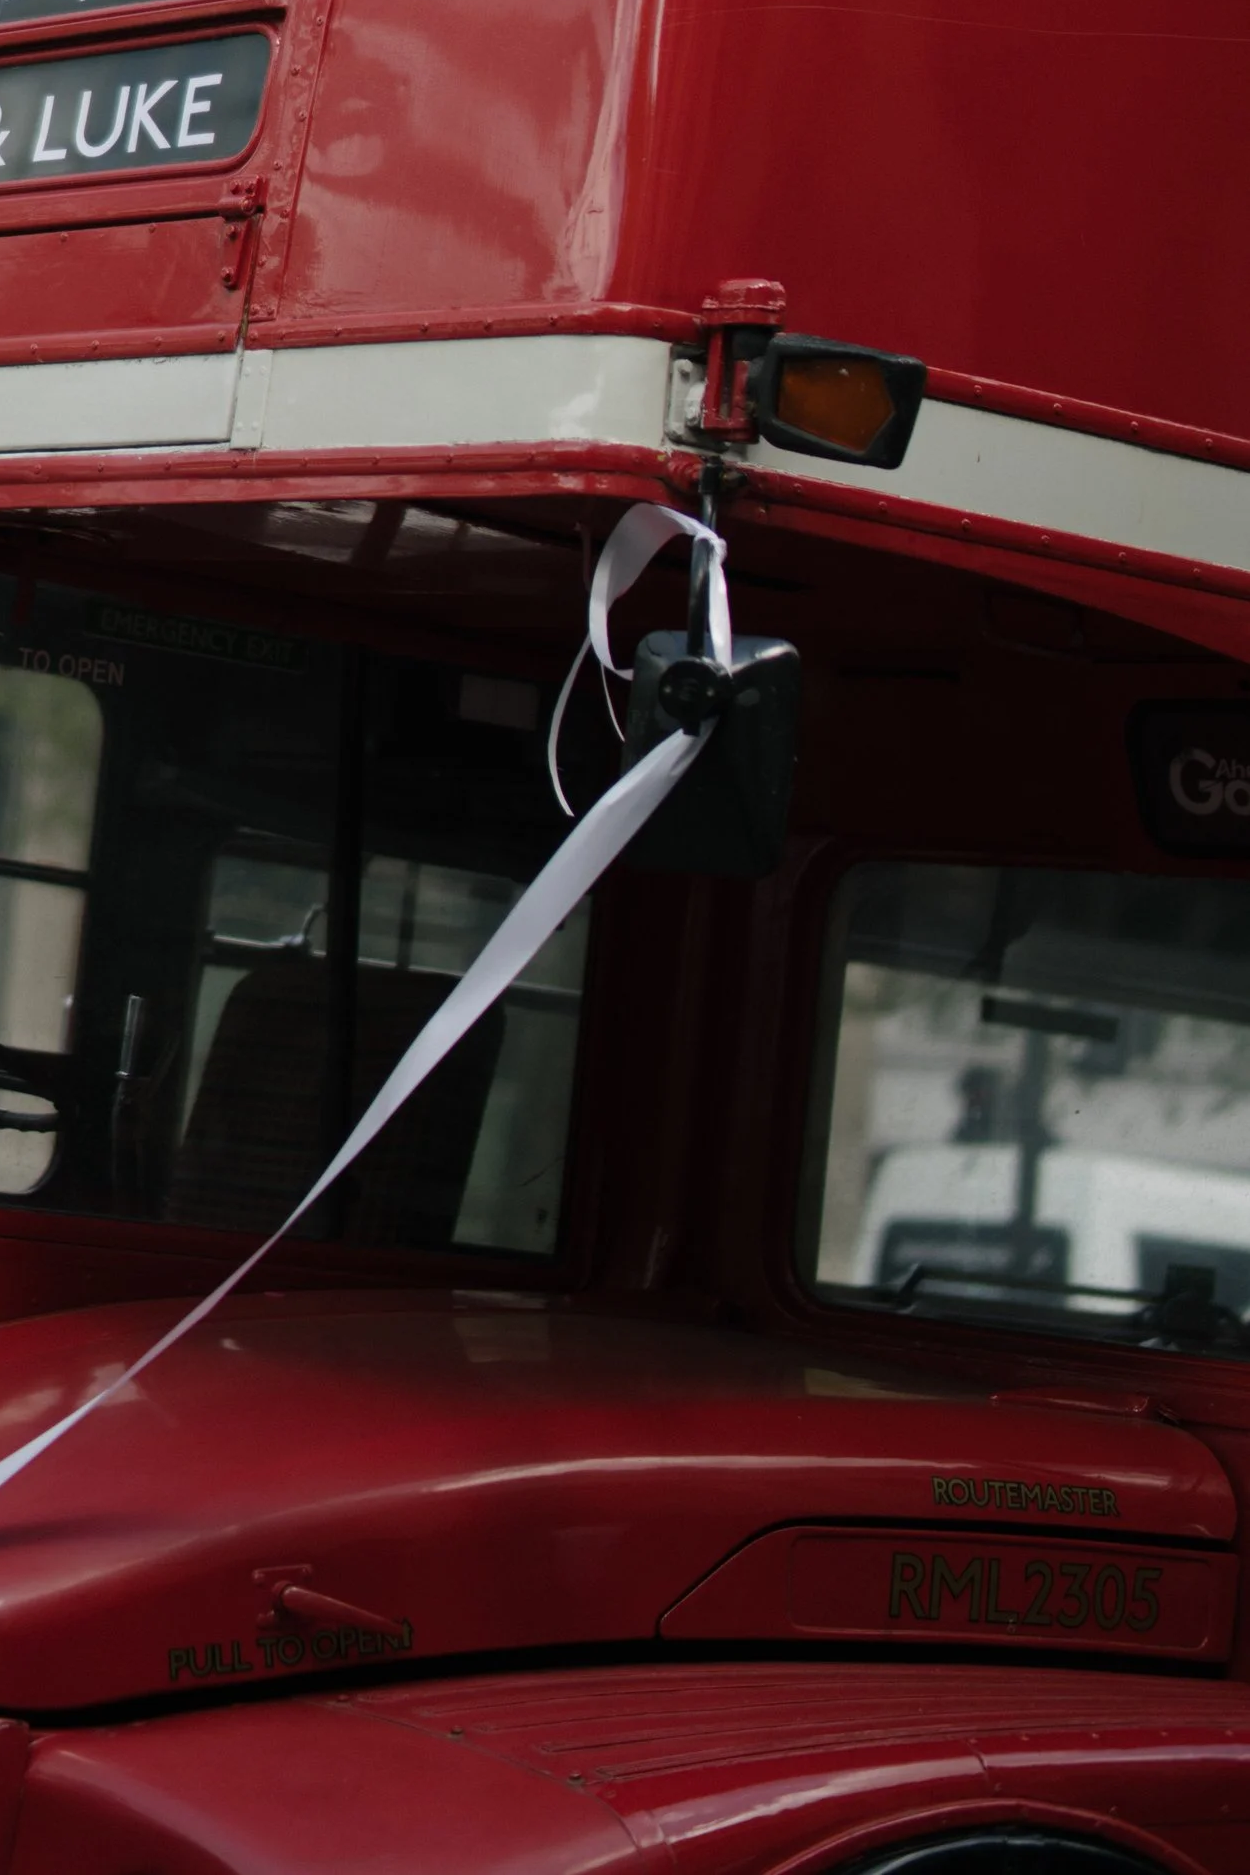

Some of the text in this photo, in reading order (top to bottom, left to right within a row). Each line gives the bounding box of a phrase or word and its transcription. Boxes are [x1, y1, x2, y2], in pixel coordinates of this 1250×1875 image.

[31, 73, 223, 163] LUKE
[100, 607, 295, 663] EMERGENCY EXIT
[19, 647, 126, 687] TO OPEN
[1214, 758, 1250, 780] Ah
[932, 1476, 1120, 1517] ROUTEMASTER
[889, 1551, 1163, 1633] RML2305
[169, 1641, 253, 1681] PULL
[258, 1634, 305, 1668] TO
